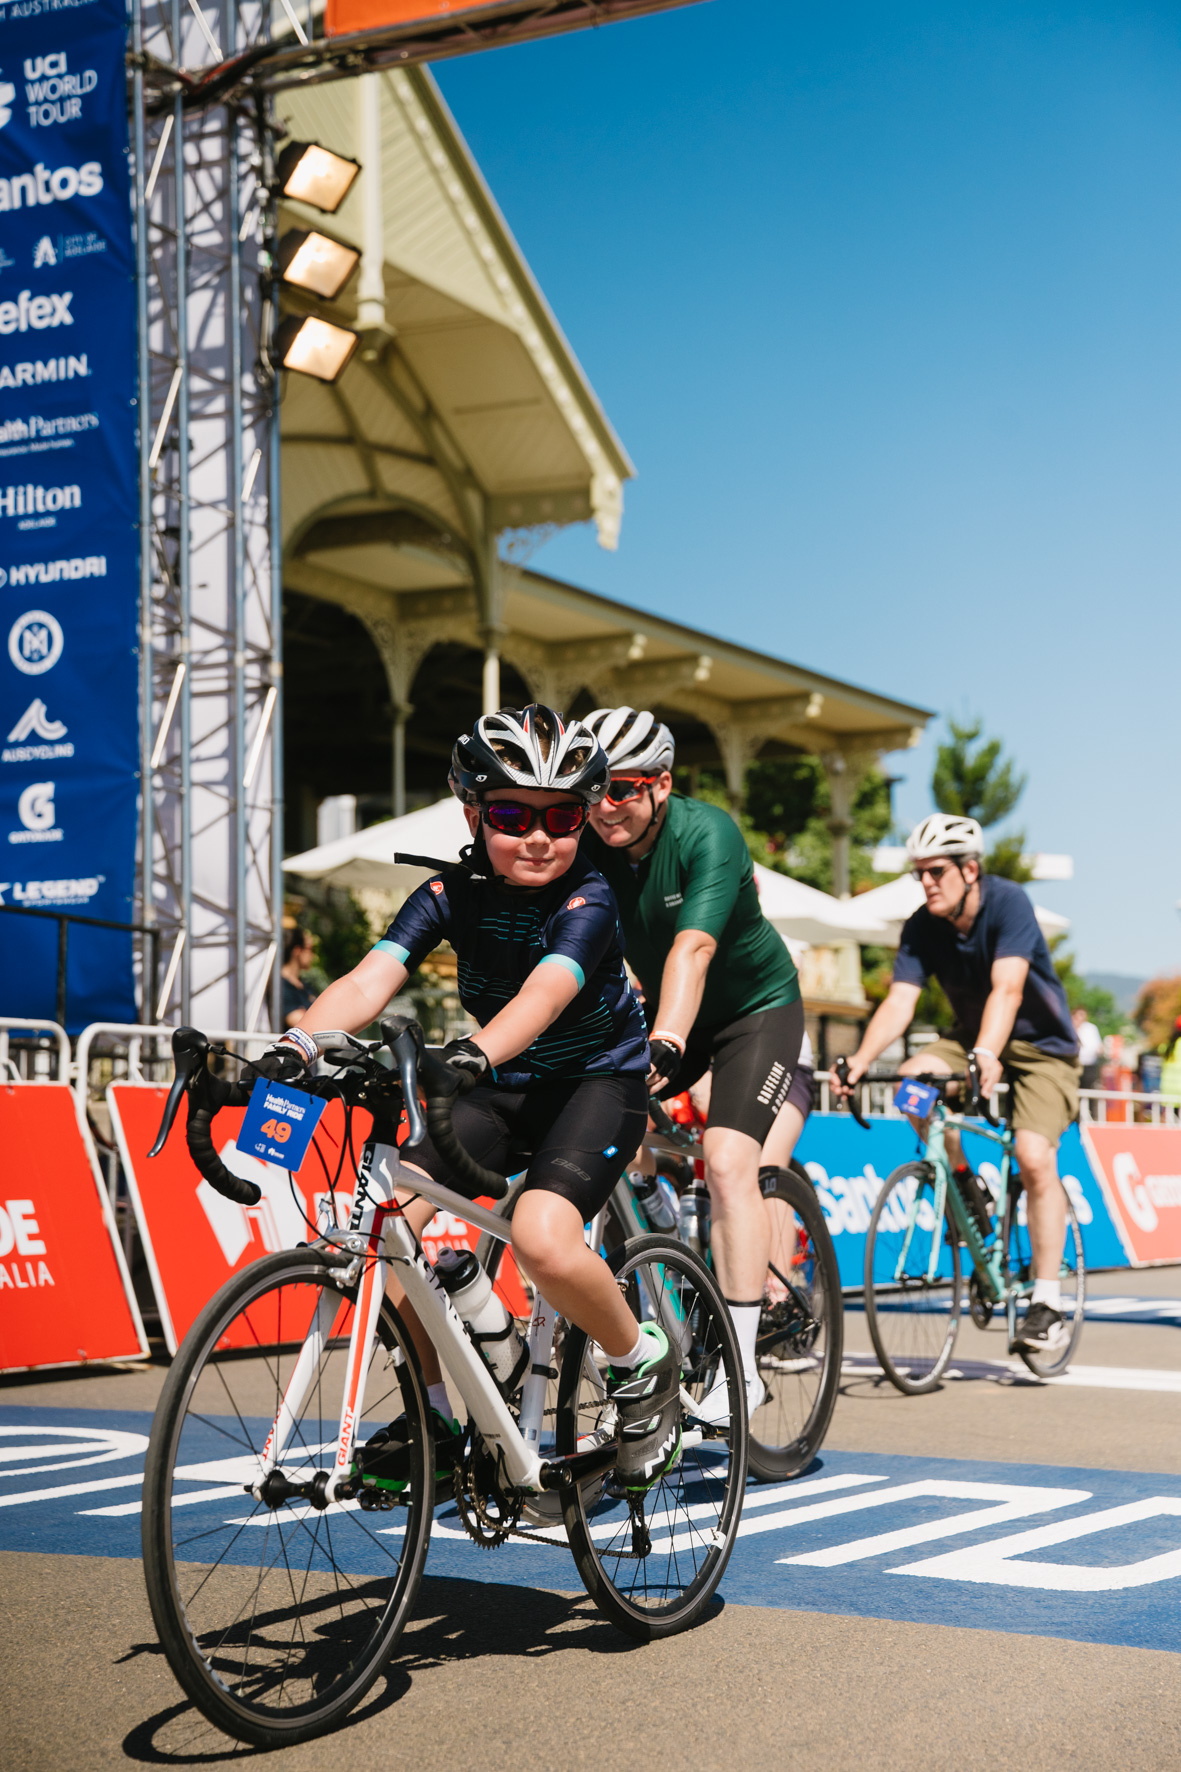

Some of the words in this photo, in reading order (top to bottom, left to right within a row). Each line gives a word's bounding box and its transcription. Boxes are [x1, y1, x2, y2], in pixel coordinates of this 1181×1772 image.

[24, 52, 67, 80] UCI
[25, 69, 98, 104] WORLD
[27, 97, 82, 128] TOUR
[29, 413, 99, 438] Partners
[0, 483, 81, 517] Hilton
[9, 555, 107, 587] HYUNDAI
[13, 878, 99, 900] LEGEND
[756, 1061, 785, 1104] CAFFEINE
[263, 1101, 287, 1115] FAMILY
[286, 1109, 304, 1121] RIDE
[265, 1093, 285, 1107] Health
[284, 1099, 307, 1113] Partners
[260, 1118, 292, 1143] 49
[350, 1143, 376, 1231] GIANT
[338, 1409, 353, 1466] GIANT
